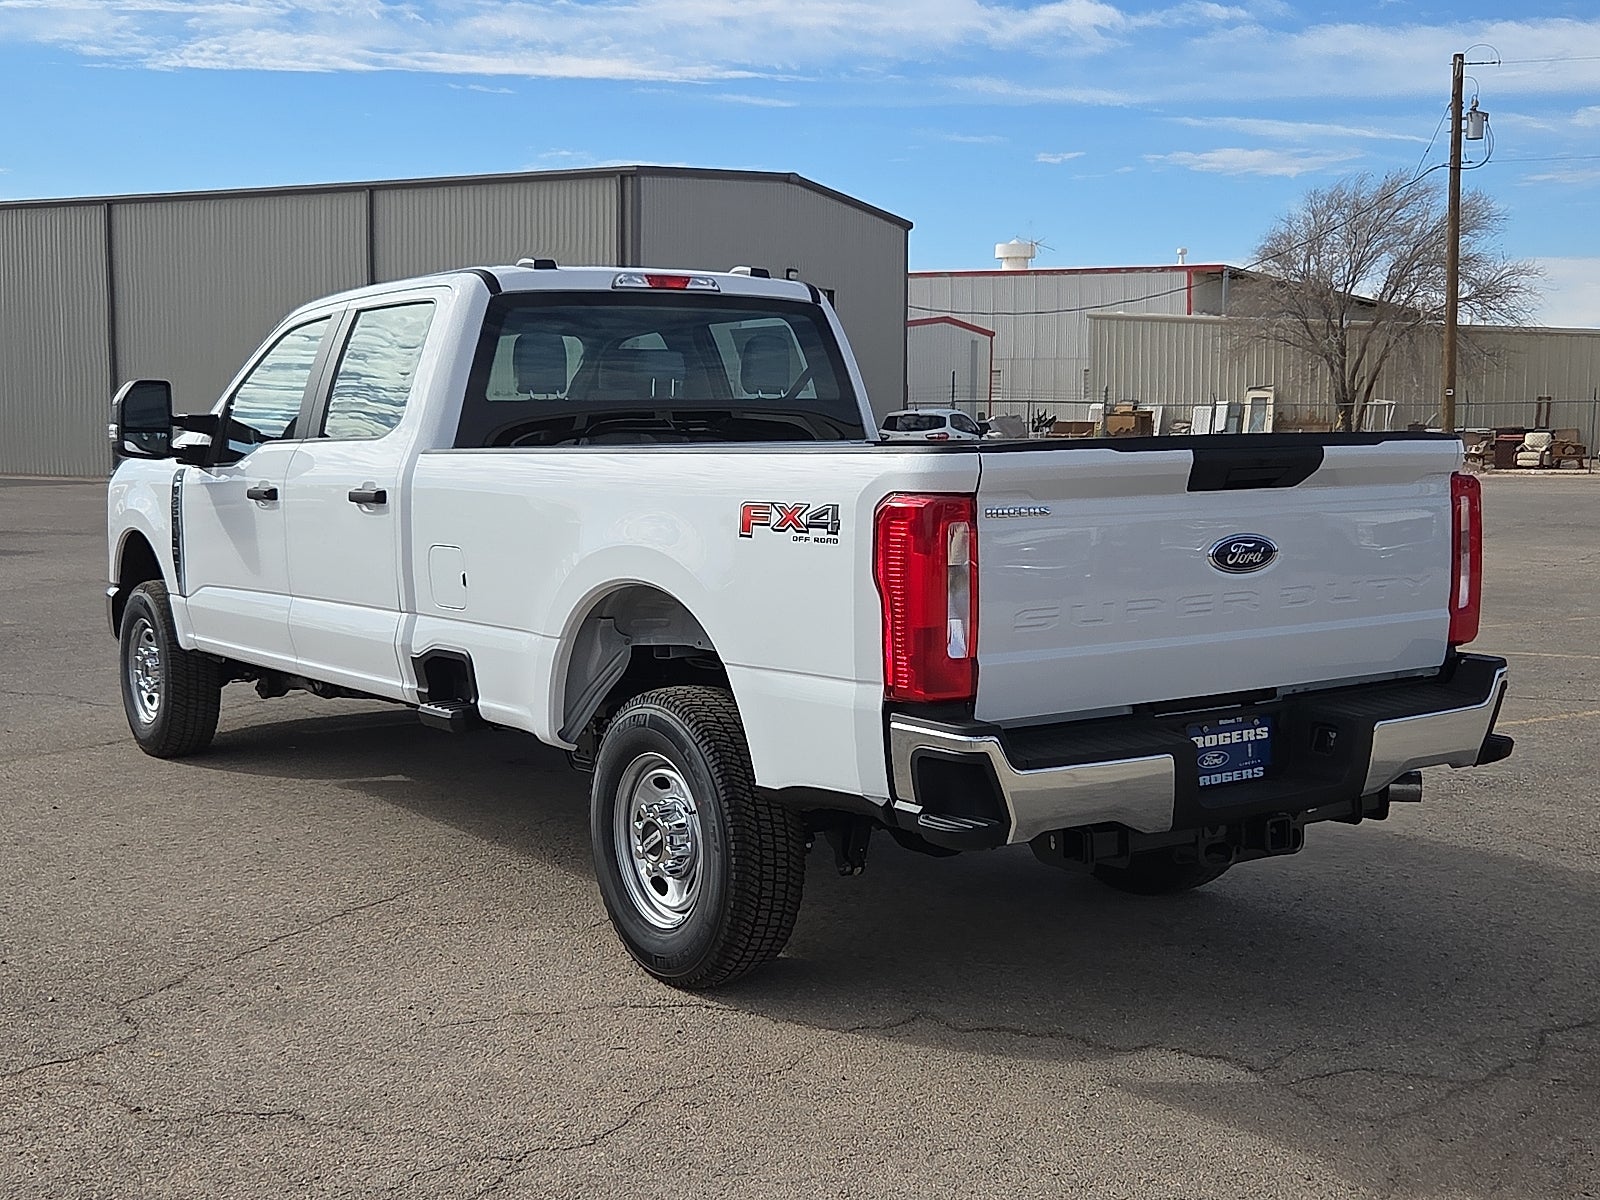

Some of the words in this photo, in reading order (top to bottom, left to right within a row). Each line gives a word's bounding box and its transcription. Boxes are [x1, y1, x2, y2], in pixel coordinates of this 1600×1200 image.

[739, 500, 840, 538] FX4
[1226, 542, 1264, 565] Ford
[1014, 589, 1260, 632] SUPER
[1280, 574, 1432, 608] DUTY
[1191, 727, 1268, 748] ROGERS
[1203, 754, 1224, 766] Ford
[1199, 767, 1264, 786] ROGERS
